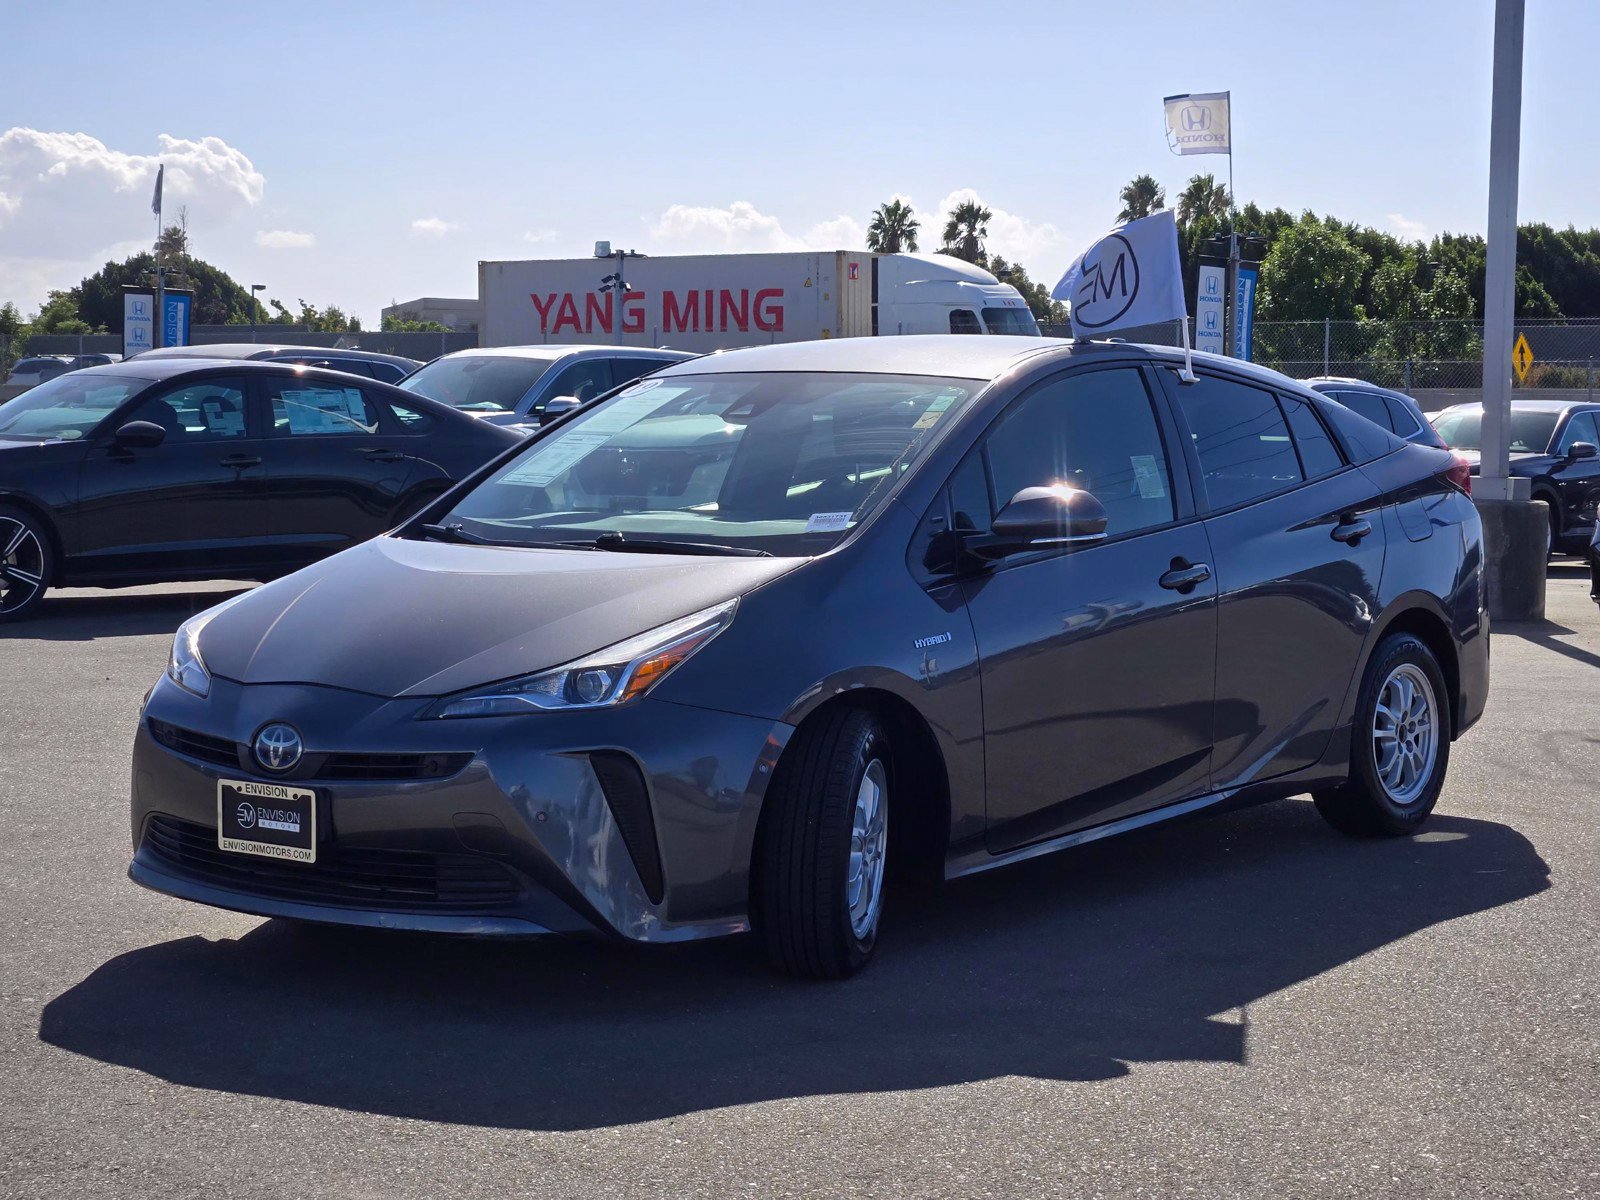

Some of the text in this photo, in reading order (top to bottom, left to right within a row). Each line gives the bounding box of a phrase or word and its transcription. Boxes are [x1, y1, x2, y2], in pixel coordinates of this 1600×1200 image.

[1199, 295, 1222, 303] HONDA
[530, 288, 784, 335] YANG MING
[914, 634, 947, 648] HYBRID
[245, 784, 288, 798] ENVISION
[258, 808, 300, 823] ENVISION
[262, 821, 297, 830] MOTORS
[224, 840, 311, 860] ENVISIONMOTORS.COM
